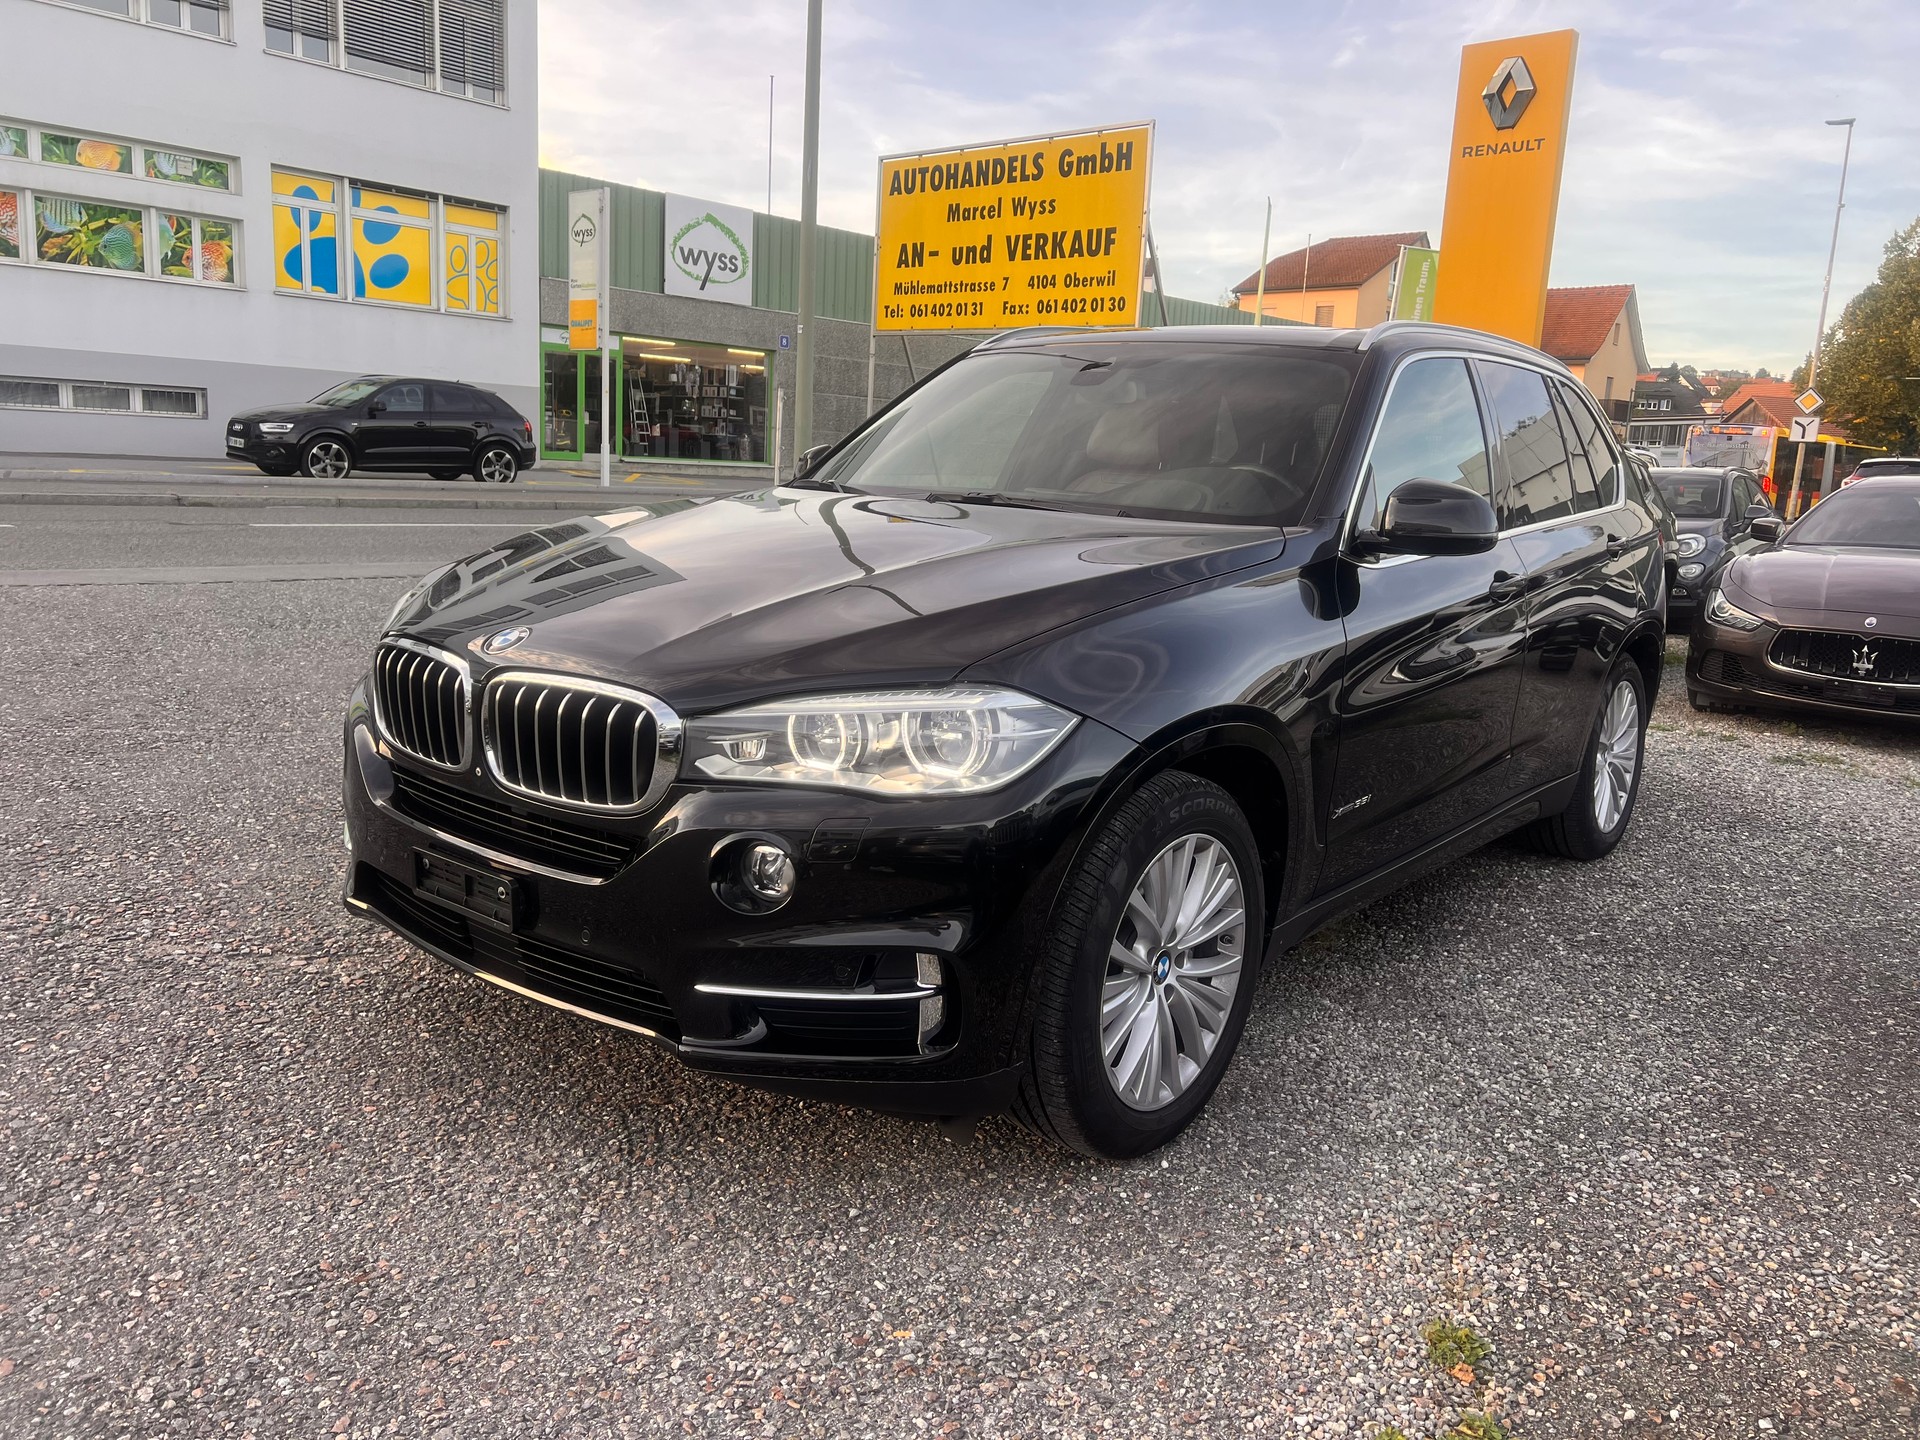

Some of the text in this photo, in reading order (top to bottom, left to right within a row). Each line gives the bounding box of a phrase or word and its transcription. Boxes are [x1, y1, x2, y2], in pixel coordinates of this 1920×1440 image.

[1462, 138, 1545, 158] RENAULT
[889, 142, 1133, 196] AUTOHANDELS GmbH
[947, 197, 1056, 223] Marcel Wyss
[573, 228, 593, 247] wyss
[951, 235, 993, 266] und
[1006, 227, 1117, 262] VERKAUF
[678, 246, 739, 290] wyss
[1416, 258, 1431, 294] Traum.
[893, 270, 1116, 296] Mühlemattstrasse 7 4104 Oberwil
[884, 304, 904, 318] Tel:
[1002, 301, 1030, 315] Fax:
[782, 338, 787, 346] 8
